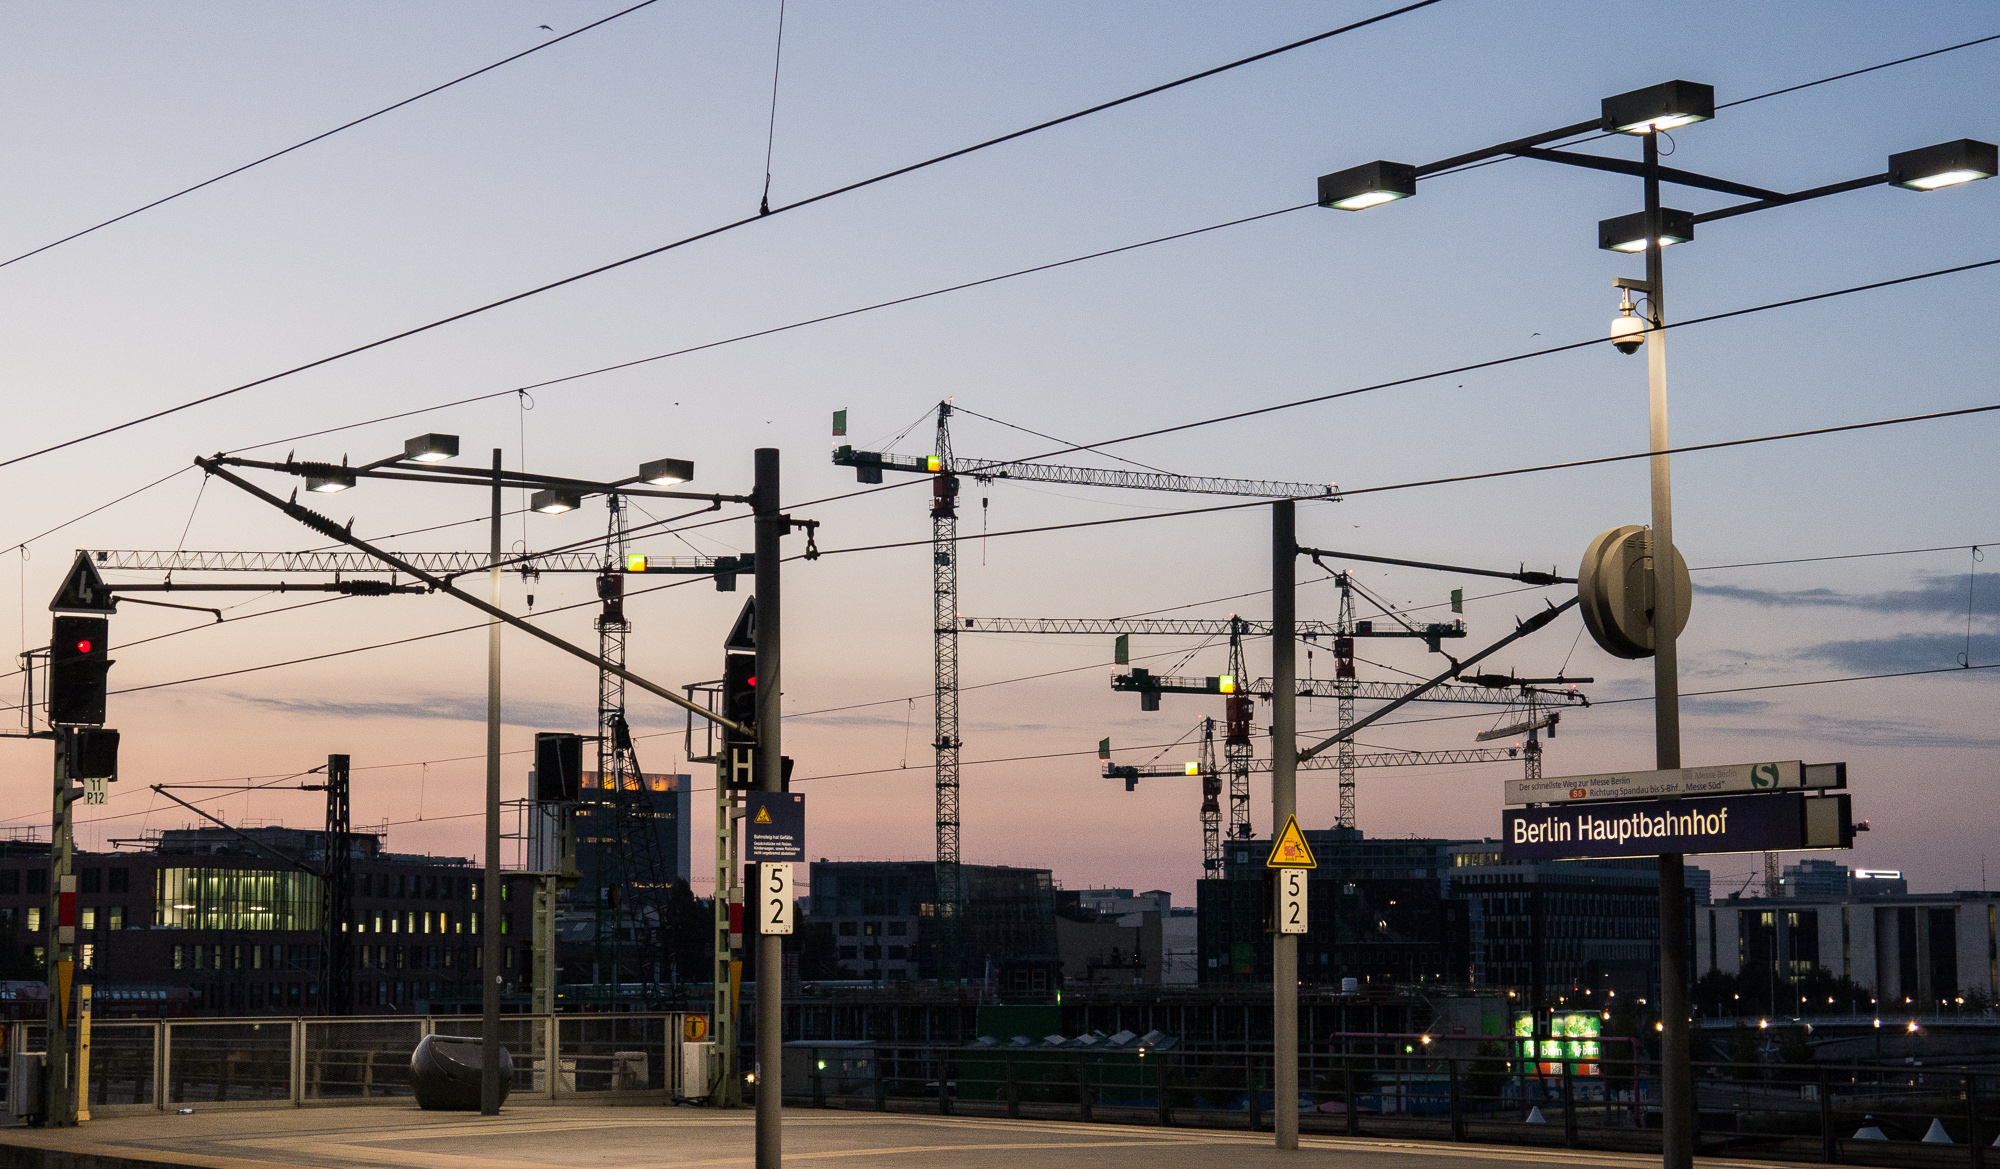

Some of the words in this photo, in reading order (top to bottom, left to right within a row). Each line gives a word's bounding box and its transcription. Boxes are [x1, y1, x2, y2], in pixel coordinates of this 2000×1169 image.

[78, 570, 93, 604] 4
[732, 748, 753, 783] H
[1752, 763, 1778, 789] S
[91, 780, 101, 791] 11
[1519, 783, 1530, 792] Der
[1531, 781, 1561, 791] schnellste
[1562, 780, 1577, 789] Weg
[1590, 778, 1610, 787] Messe
[1611, 777, 1631, 786] Berlin
[1572, 789, 1583, 798] S5
[1589, 788, 1618, 798] Richtung
[1619, 786, 1648, 796] Spandau
[1649, 785, 1659, 794] bis
[1660, 783, 1681, 793] S-Bhf.
[87, 791, 105, 804] P12
[1513, 816, 1571, 844] Berlin
[1578, 807, 1728, 845] Hauptbahnhof
[769, 868, 784, 893] 5
[1288, 874, 1300, 897] 5
[770, 898, 784, 924] 2
[1288, 901, 1300, 924] 2
[83, 999, 90, 1011] F
[1537, 1010, 1550, 1035] H
[1541, 1045, 1562, 1056] bam
[1582, 1044, 1599, 1055] bam
